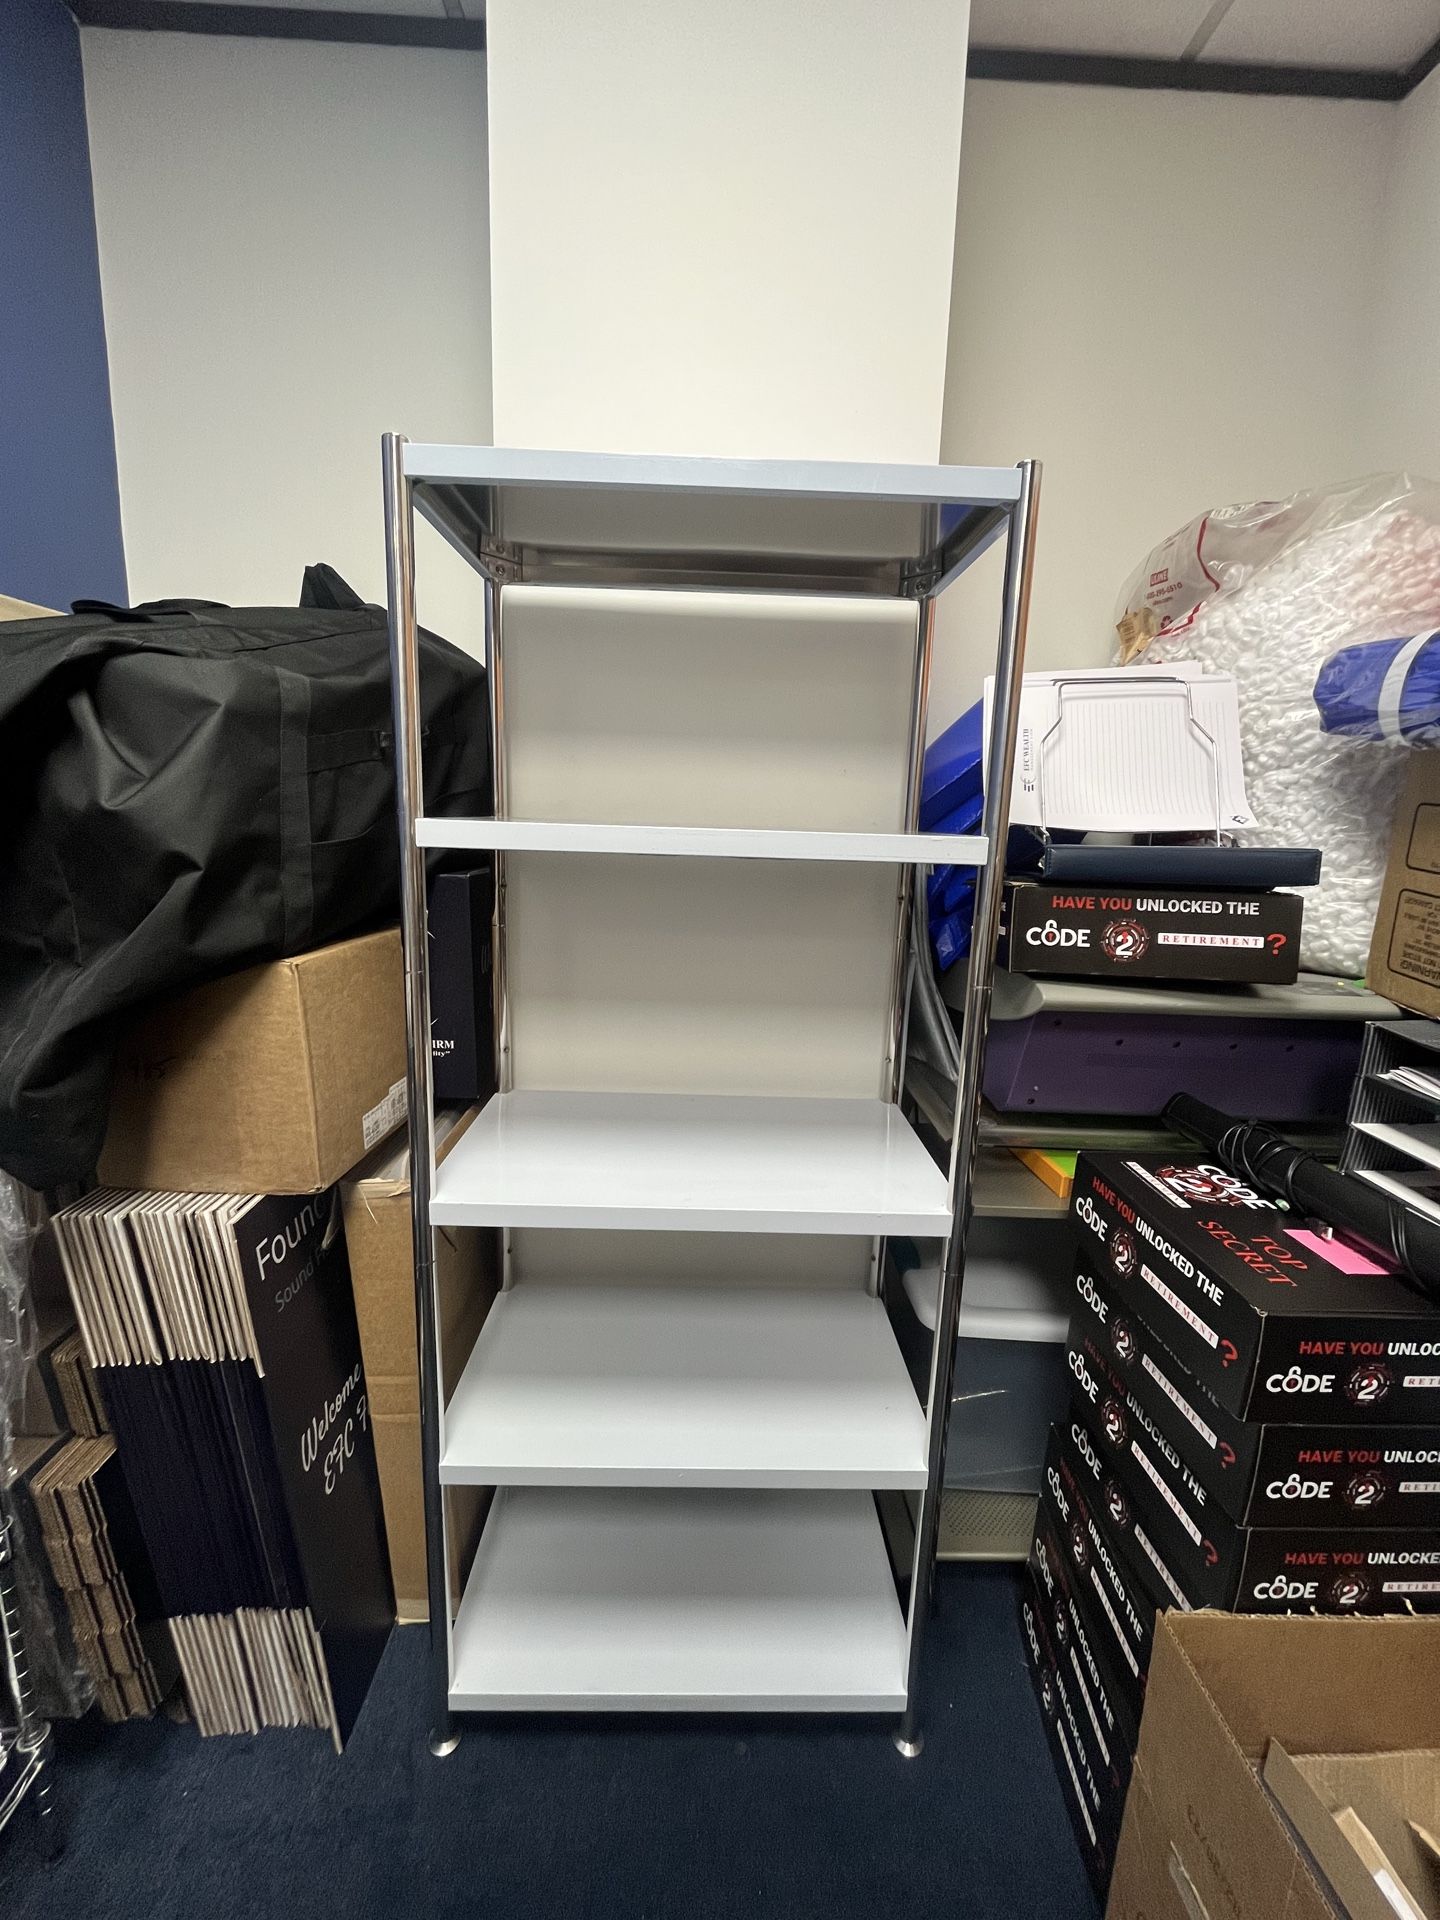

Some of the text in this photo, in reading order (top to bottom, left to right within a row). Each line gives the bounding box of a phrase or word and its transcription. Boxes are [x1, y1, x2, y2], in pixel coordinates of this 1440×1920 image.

[1052, 895, 1260, 915] HAVE YOU UNLOCKED THE
[1026, 919, 1091, 948] CODE
[1115, 933, 1134, 956] 2
[1162, 934, 1260, 947] RETIREMENT
[1075, 1197, 1108, 1242] CODE
[1142, 1266, 1217, 1344] RETIREMENT
[1092, 1176, 1117, 1207] HAVE
[1116, 1199, 1136, 1224] YOU
[1135, 1217, 1195, 1279] UNLOCKED
[1196, 1270, 1224, 1306] THE
[1196, 1219, 1298, 1288] SECRET
[1250, 1235, 1307, 1270] TOP
[1076, 1274, 1109, 1324] CODE
[1143, 1357, 1214, 1444] RETIREMENT
[1265, 1365, 1336, 1393] CODE
[1299, 1341, 1346, 1355] HAVE
[1350, 1341, 1384, 1355] YOU
[301, 1363, 361, 1472] Welcome
[1068, 1351, 1099, 1404] CODE
[1133, 1445, 1200, 1543] RETIREMENT
[1126, 1391, 1180, 1469] UNLOCKED
[1182, 1464, 1208, 1506] THE
[1266, 1473, 1334, 1499] CODE
[1297, 1450, 1440, 1463] HAVE YOU UNLOC
[1047, 1466, 1070, 1523] CODE
[1071, 1424, 1102, 1480] CODE
[1136, 1527, 1192, 1611] RETIREME
[1087, 1519, 1125, 1602] UNLOCKED
[1125, 1599, 1144, 1643] THE
[1253, 1575, 1319, 1600] CODE
[1284, 1552, 1328, 1564] HAVE
[1332, 1552, 1365, 1565] YOU
[1068, 1598, 1099, 1689] UNLOCKED
[1099, 1685, 1115, 1732] THE
